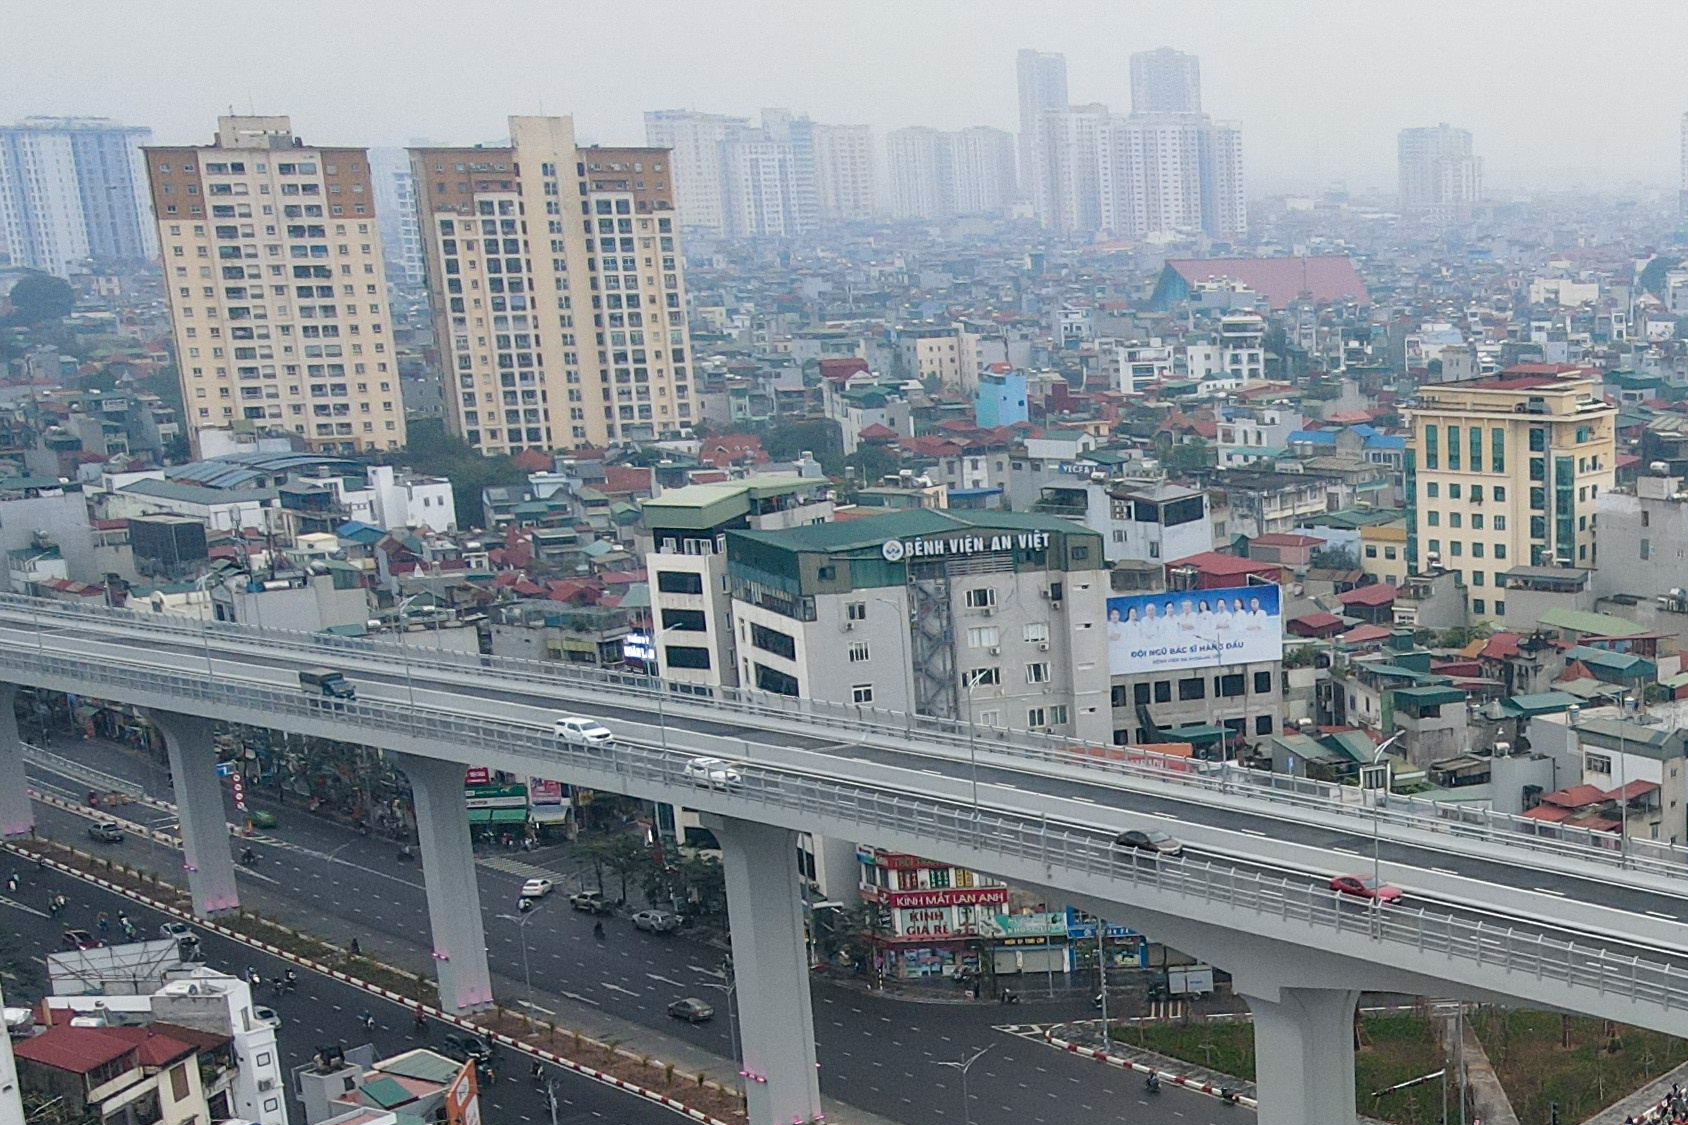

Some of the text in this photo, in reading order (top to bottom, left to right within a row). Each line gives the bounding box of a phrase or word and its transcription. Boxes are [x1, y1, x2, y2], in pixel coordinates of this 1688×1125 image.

[950, 535, 984, 556] VIỆN
[991, 535, 1012, 551] AN
[1018, 530, 1050, 551] VIỆT
[896, 890, 1004, 907] KÍNH MẮT LAN ANH
[909, 909, 944, 922] KÍNH
